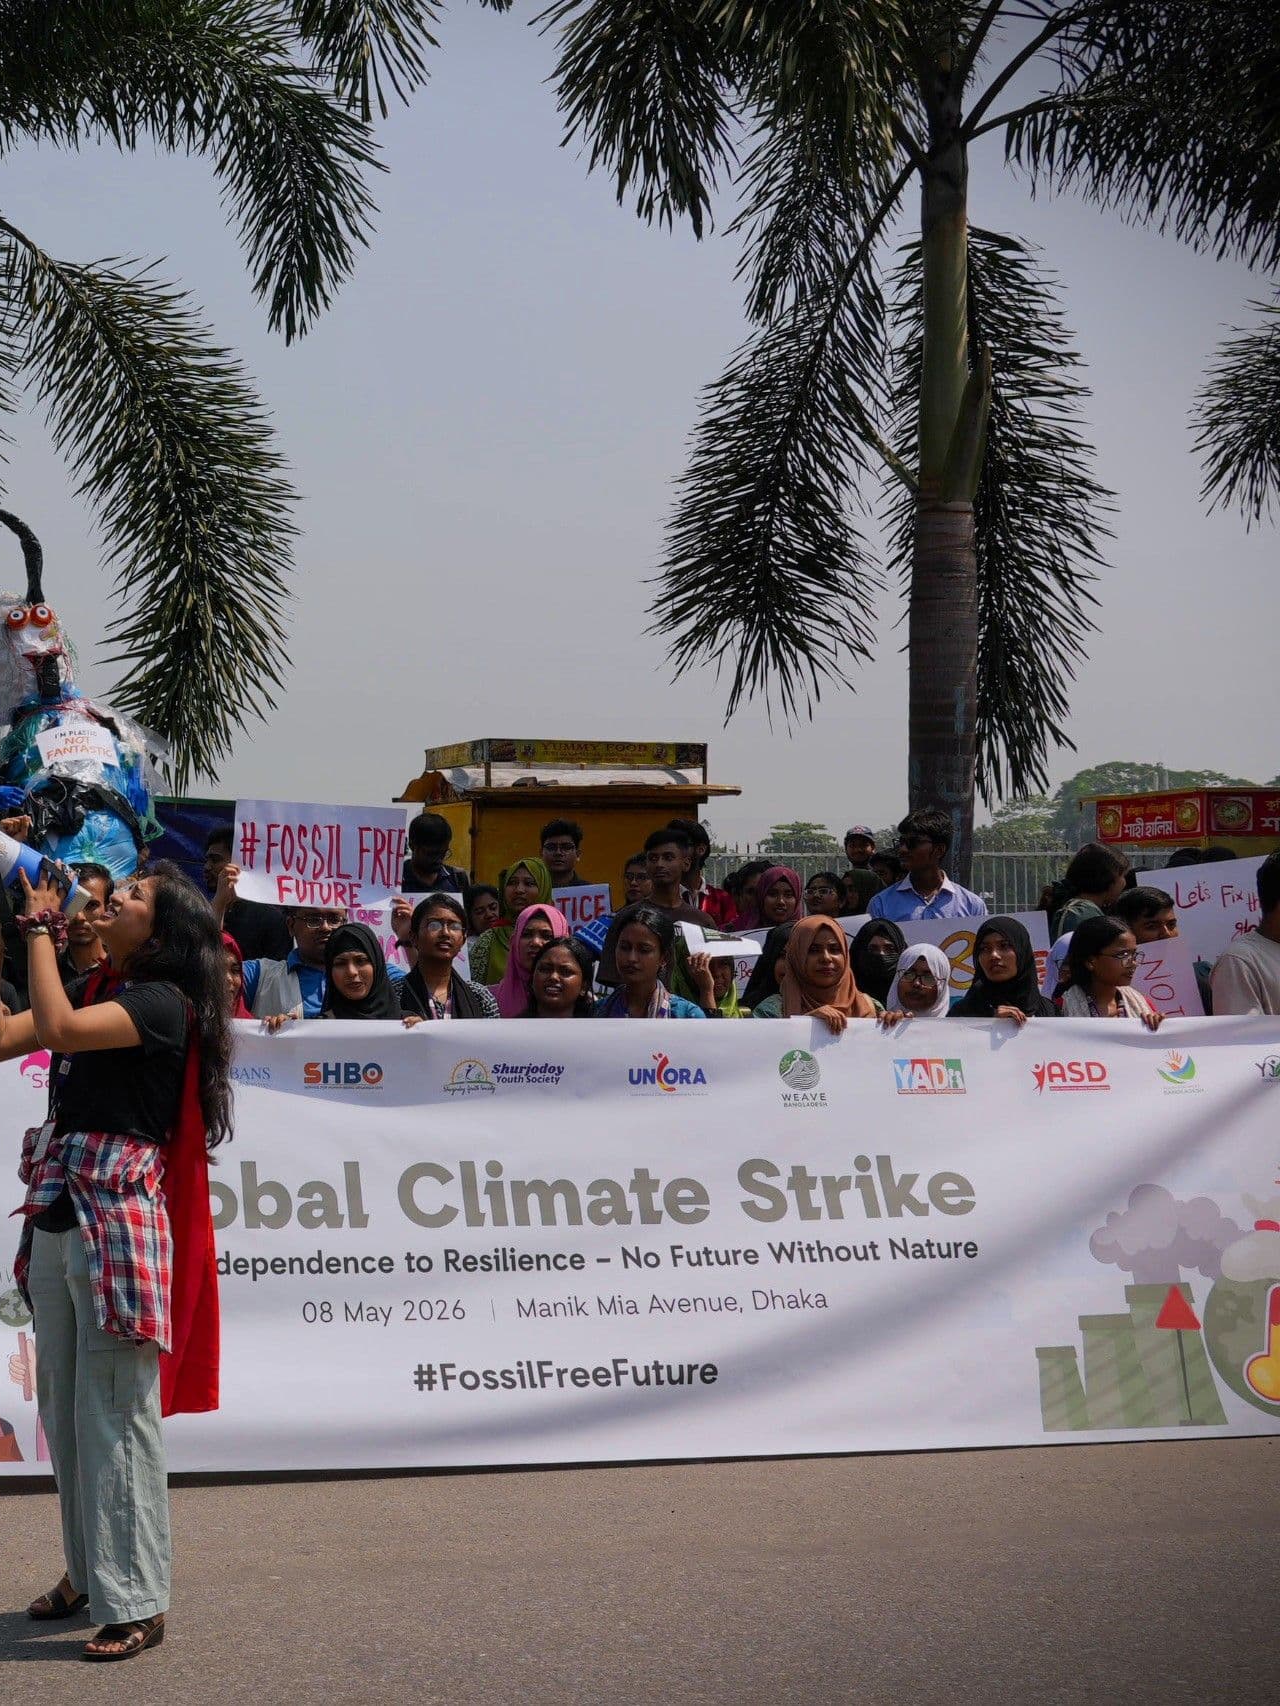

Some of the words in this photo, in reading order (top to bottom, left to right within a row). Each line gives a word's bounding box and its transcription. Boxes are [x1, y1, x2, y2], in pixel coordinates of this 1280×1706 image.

[46, 744, 113, 760] FANTASTIC
[64, 736, 90, 745] NOT
[358, 826, 406, 889] FREE
[276, 875, 362, 909] FUTURE
[1175, 880, 1211, 909] Let's
[1221, 884, 1243, 908] Fix
[304, 1062, 383, 1084] SHBO
[491, 1062, 565, 1077] Shurjodoy
[496, 1075, 524, 1084] Youth
[526, 1074, 561, 1085] Society
[1047, 1061, 1107, 1083] ASD
[781, 1093, 827, 1102] WEAVE
[397, 1159, 711, 1229] Climate
[737, 1154, 977, 1223] Strike
[405, 1252, 434, 1273] to
[443, 1247, 586, 1273] Resilience
[621, 1246, 661, 1270] No
[670, 1245, 760, 1268] Future
[767, 1240, 881, 1264] Without
[888, 1237, 979, 1261] Nature
[302, 1300, 334, 1323] 08
[344, 1300, 393, 1327] May
[403, 1299, 466, 1321] 2026
[517, 1295, 589, 1318] Manik
[597, 1295, 640, 1317] Mia
[648, 1293, 744, 1316] Avenue,
[752, 1288, 829, 1311] Dhaka
[413, 1358, 719, 1392] #FossilFreeFuture
